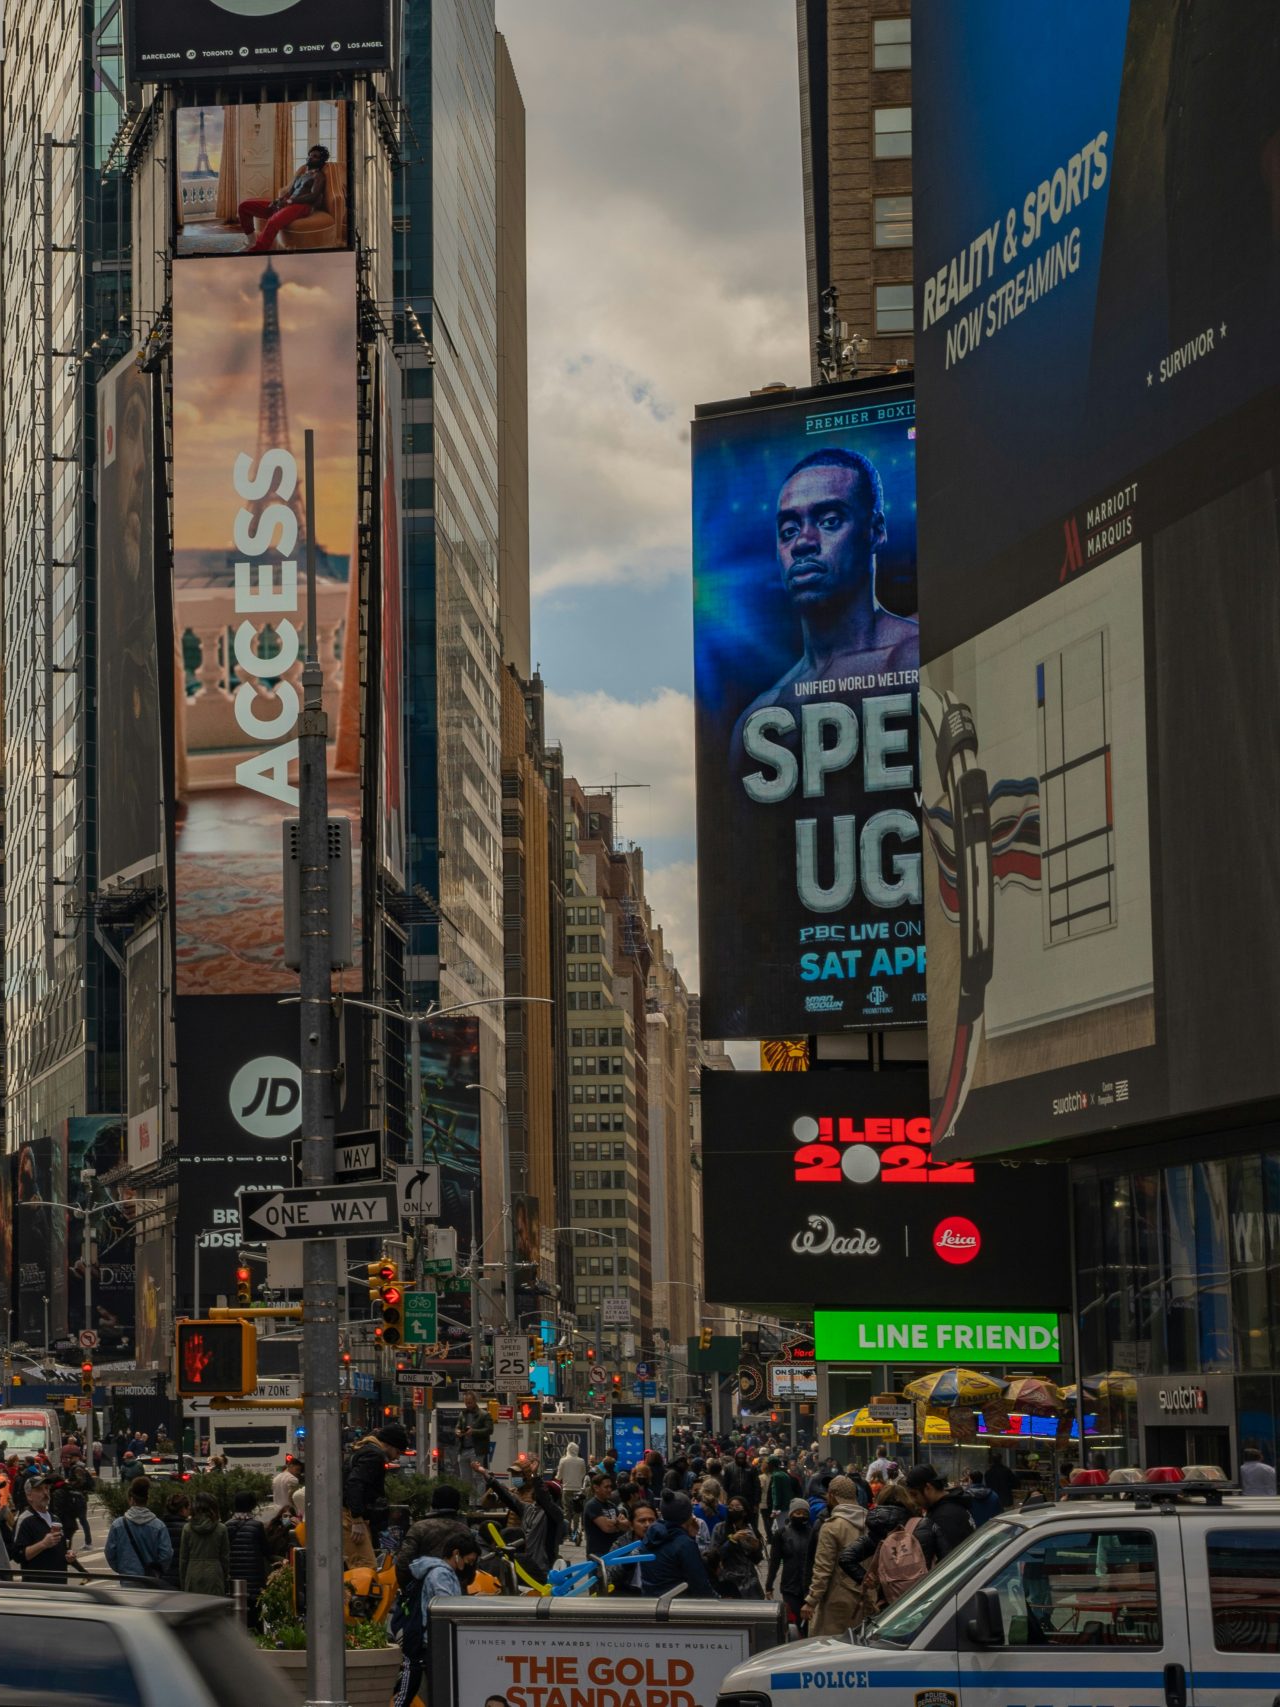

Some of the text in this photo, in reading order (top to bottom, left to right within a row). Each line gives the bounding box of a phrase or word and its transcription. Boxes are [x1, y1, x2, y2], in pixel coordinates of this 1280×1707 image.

[299, 44, 325, 52] SYDNEY
[923, 130, 1109, 332] REALITY & SPORTS
[946, 226, 1081, 370] NOW STREAMING
[1160, 328, 1214, 383] SURVIVOR
[806, 411, 869, 431] PREMIER
[1087, 483, 1138, 530] MARRIOTT
[1087, 516, 1133, 558] MARQUIS
[233, 448, 299, 808] ACCESS
[794, 679, 836, 697] UNIFIED
[838, 674, 875, 692] WORLD
[742, 692, 920, 804] SPE
[800, 920, 922, 941] PBC LIVE ON
[800, 950, 863, 982] SAT
[241, 1077, 300, 1117] JD
[1052, 1090, 1084, 1116] swatch
[343, 1148, 370, 1168] WAY
[266, 1201, 376, 1226] ONE WAY
[404, 1202, 432, 1213] ONLY
[791, 1214, 880, 1256] Wade
[936, 1229, 976, 1248] Leica
[450, 1280, 460, 1290] 45
[858, 1324, 928, 1350] LINE
[793, 1347, 815, 1359] Hard
[499, 1358, 525, 1374] 25
[124, 1386, 156, 1396] HOTDOGS
[268, 1385, 290, 1396] ZONE
[1159, 1386, 1197, 1410] swatch
[468, 1638, 507, 1646] WINNER
[551, 1640, 590, 1648] AWARDS
[596, 1640, 650, 1648] INCLUDING
[685, 1642, 731, 1650] MUSICAL
[588, 1658, 694, 1687] GOLD
[801, 1670, 868, 1689] POLICE
[925, 1692, 947, 1700] POLICE
